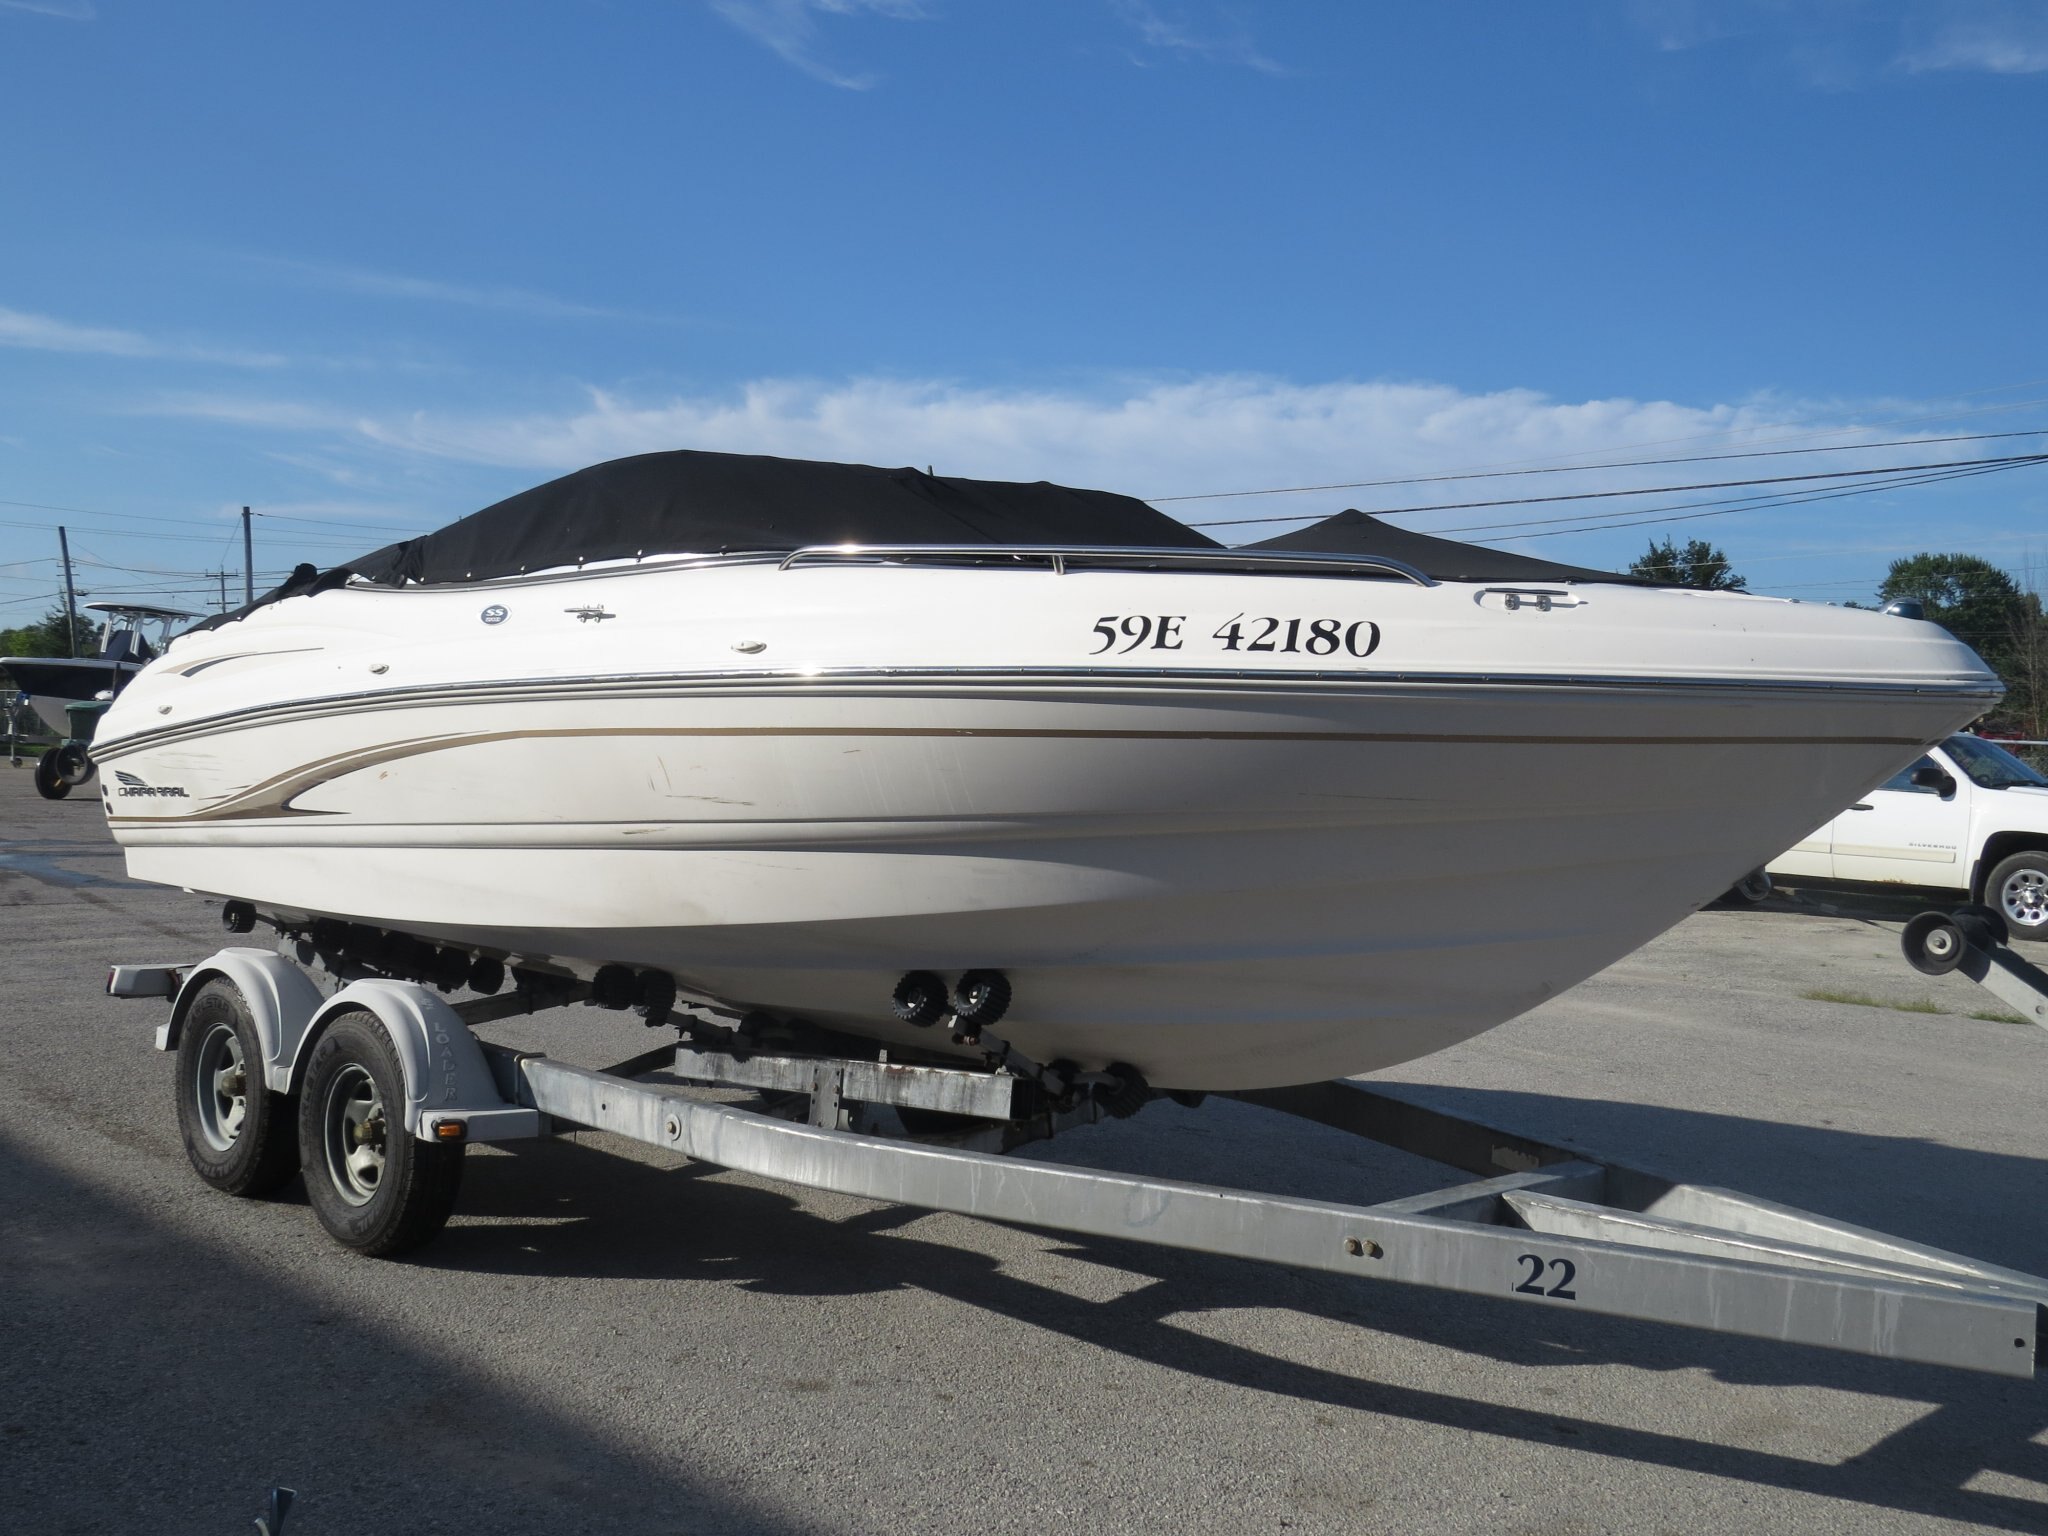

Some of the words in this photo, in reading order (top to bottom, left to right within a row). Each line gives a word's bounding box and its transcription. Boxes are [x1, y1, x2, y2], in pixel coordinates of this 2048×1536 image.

[485, 608, 504, 616] SS
[1089, 615, 1187, 655] 59E
[1212, 612, 1381, 658] 42180
[1515, 1254, 1576, 1300] 22
